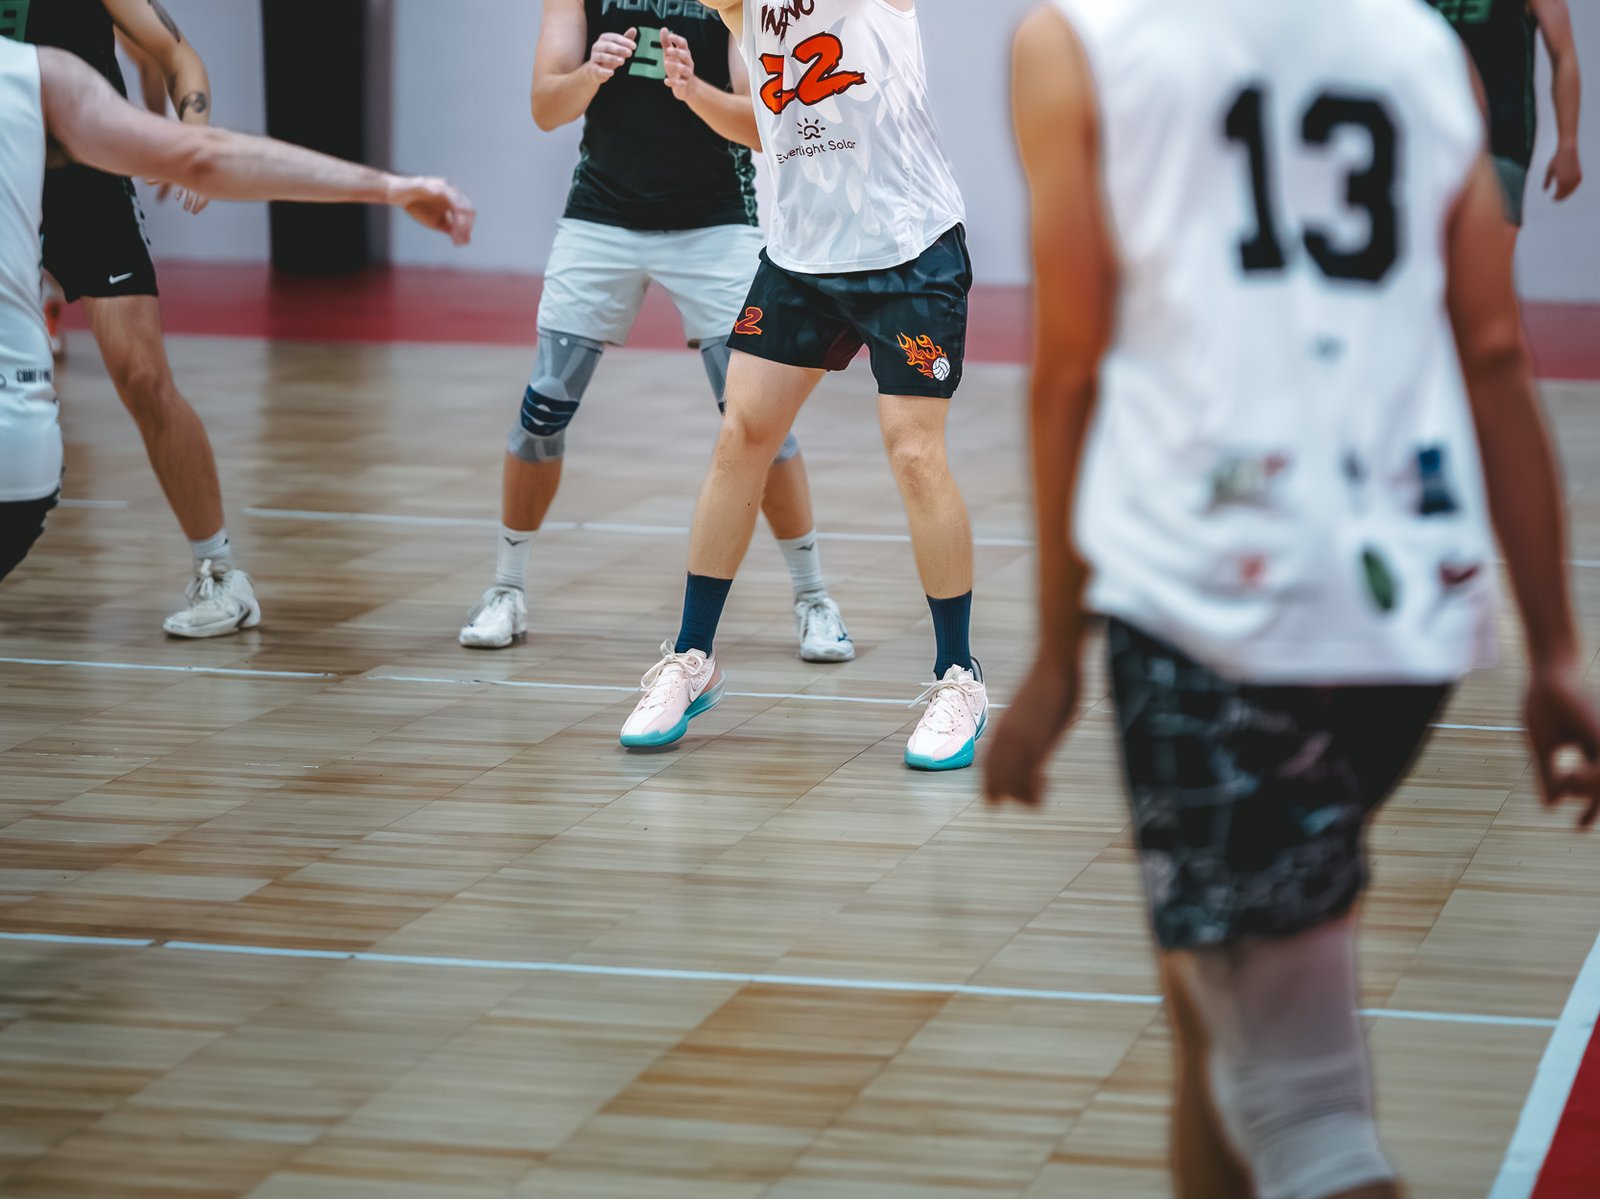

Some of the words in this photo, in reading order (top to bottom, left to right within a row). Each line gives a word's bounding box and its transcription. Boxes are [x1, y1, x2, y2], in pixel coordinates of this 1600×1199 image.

[759, 31, 867, 115] 22
[776, 143, 826, 164] Everlight
[828, 139, 856, 151] Solar
[1224, 86, 1402, 283] 13
